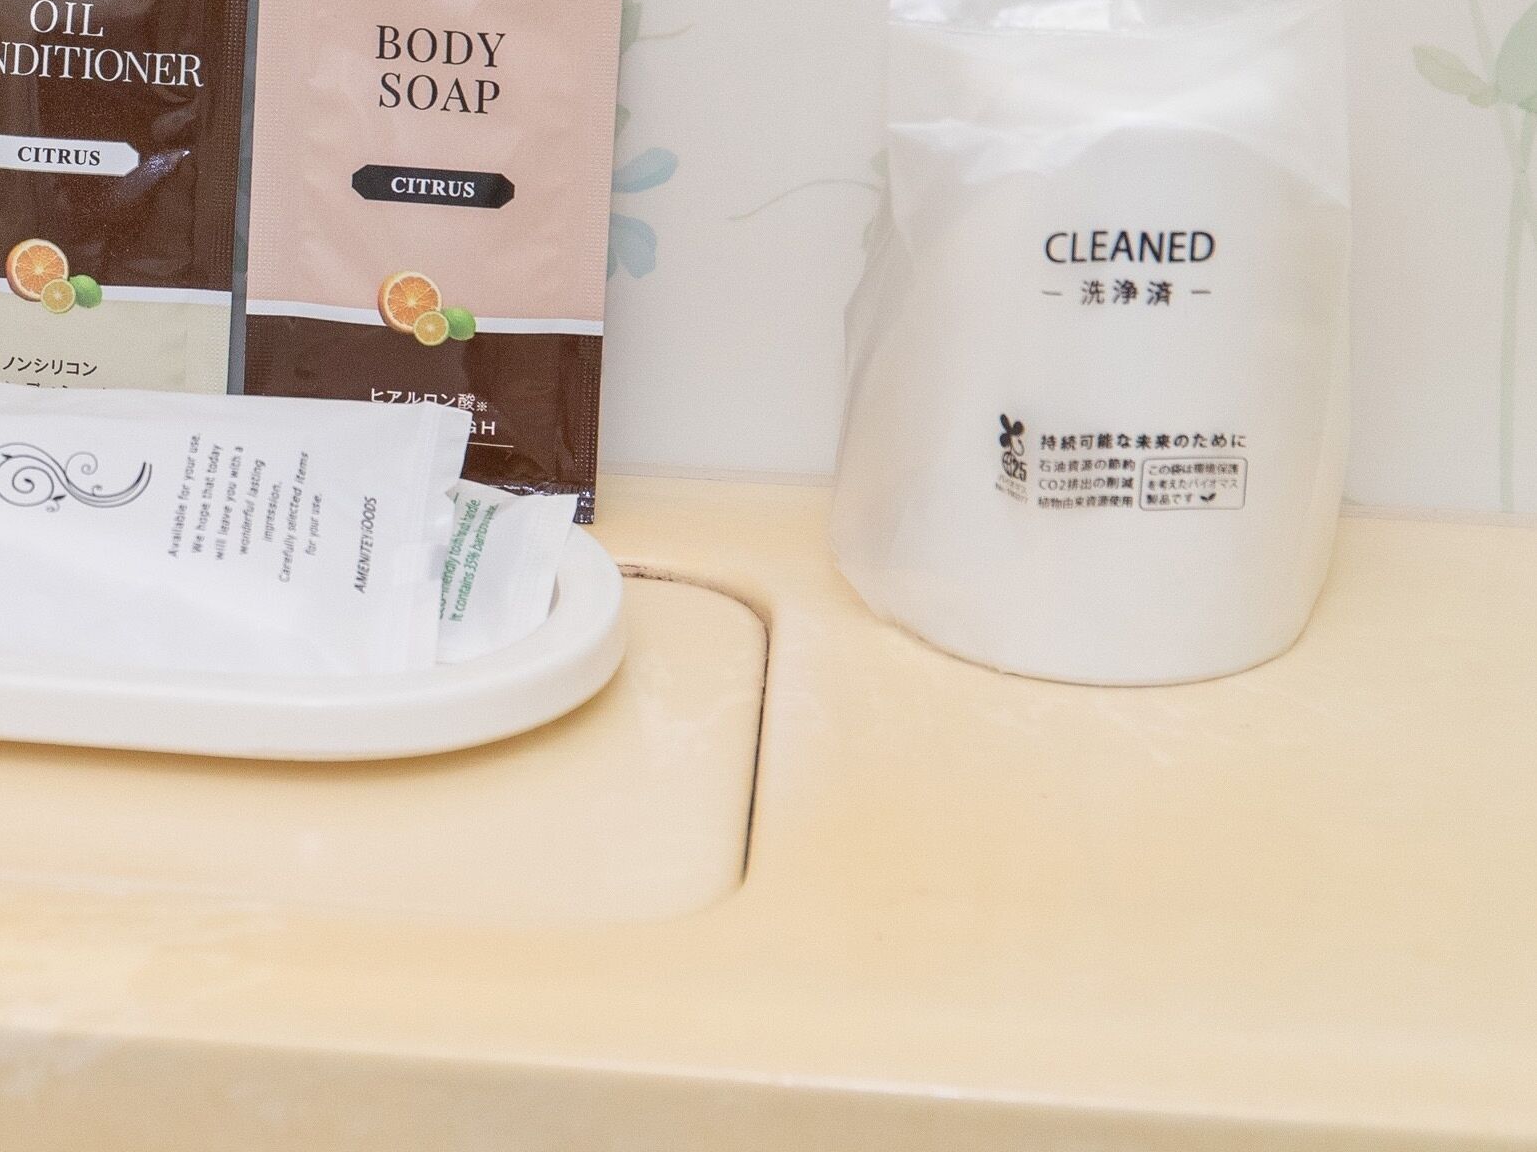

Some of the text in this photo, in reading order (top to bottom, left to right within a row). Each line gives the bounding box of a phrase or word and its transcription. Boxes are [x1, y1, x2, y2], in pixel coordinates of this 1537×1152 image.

[29, 0, 104, 38] OIL
[376, 25, 505, 69] BODY
[379, 71, 501, 115] SOAP
[17, 146, 101, 168] CITRUS
[390, 176, 476, 198] CITRUS
[1045, 230, 1216, 264] CLEANED
[3, 356, 97, 376] ノンシリコン
[1040, 433, 1247, 451] 持続可能な未来のために
[184, 456, 198, 481] your
[229, 454, 242, 477] with
[177, 484, 191, 501] for
[192, 443, 223, 554] We hope that today
[226, 480, 237, 503] you
[239, 458, 265, 555] wonderful lasting
[168, 501, 187, 558] Available
[218, 505, 233, 536] leave
[278, 451, 309, 583] Carefully selected items
[215, 538, 226, 560] will
[455, 571, 475, 612] contains
